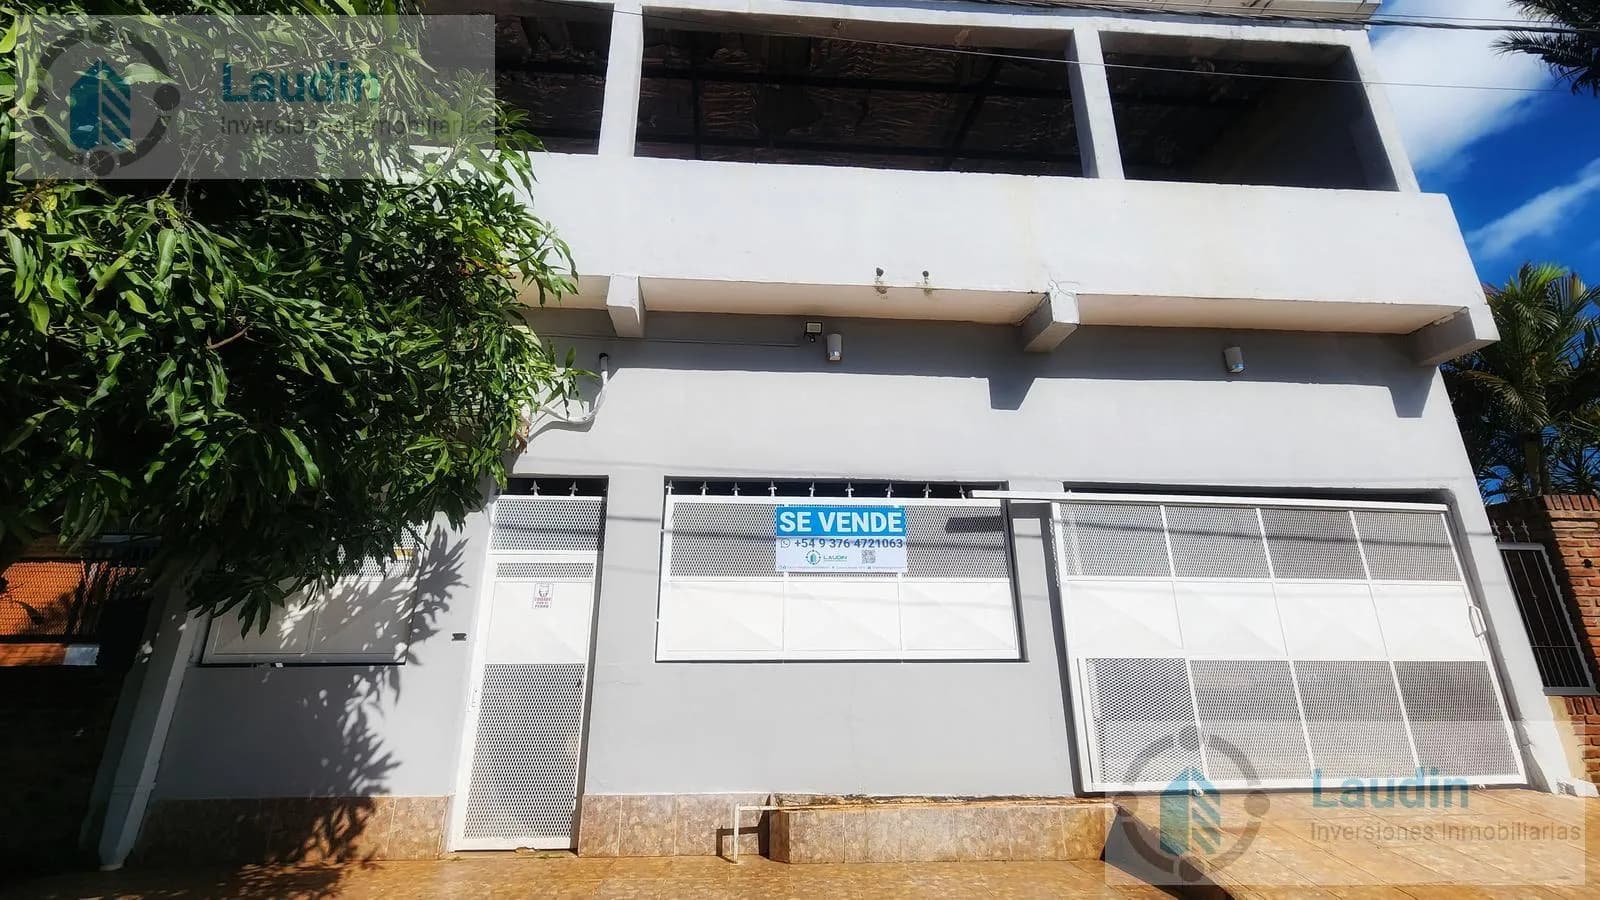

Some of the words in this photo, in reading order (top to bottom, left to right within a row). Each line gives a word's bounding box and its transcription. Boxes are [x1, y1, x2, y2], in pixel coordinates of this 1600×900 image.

[780, 511, 812, 533] SE
[818, 512, 903, 533] VENDE
[794, 538, 815, 548] +54
[819, 538, 826, 548] 9
[829, 538, 850, 548] 376
[853, 538, 903, 548] 4721063
